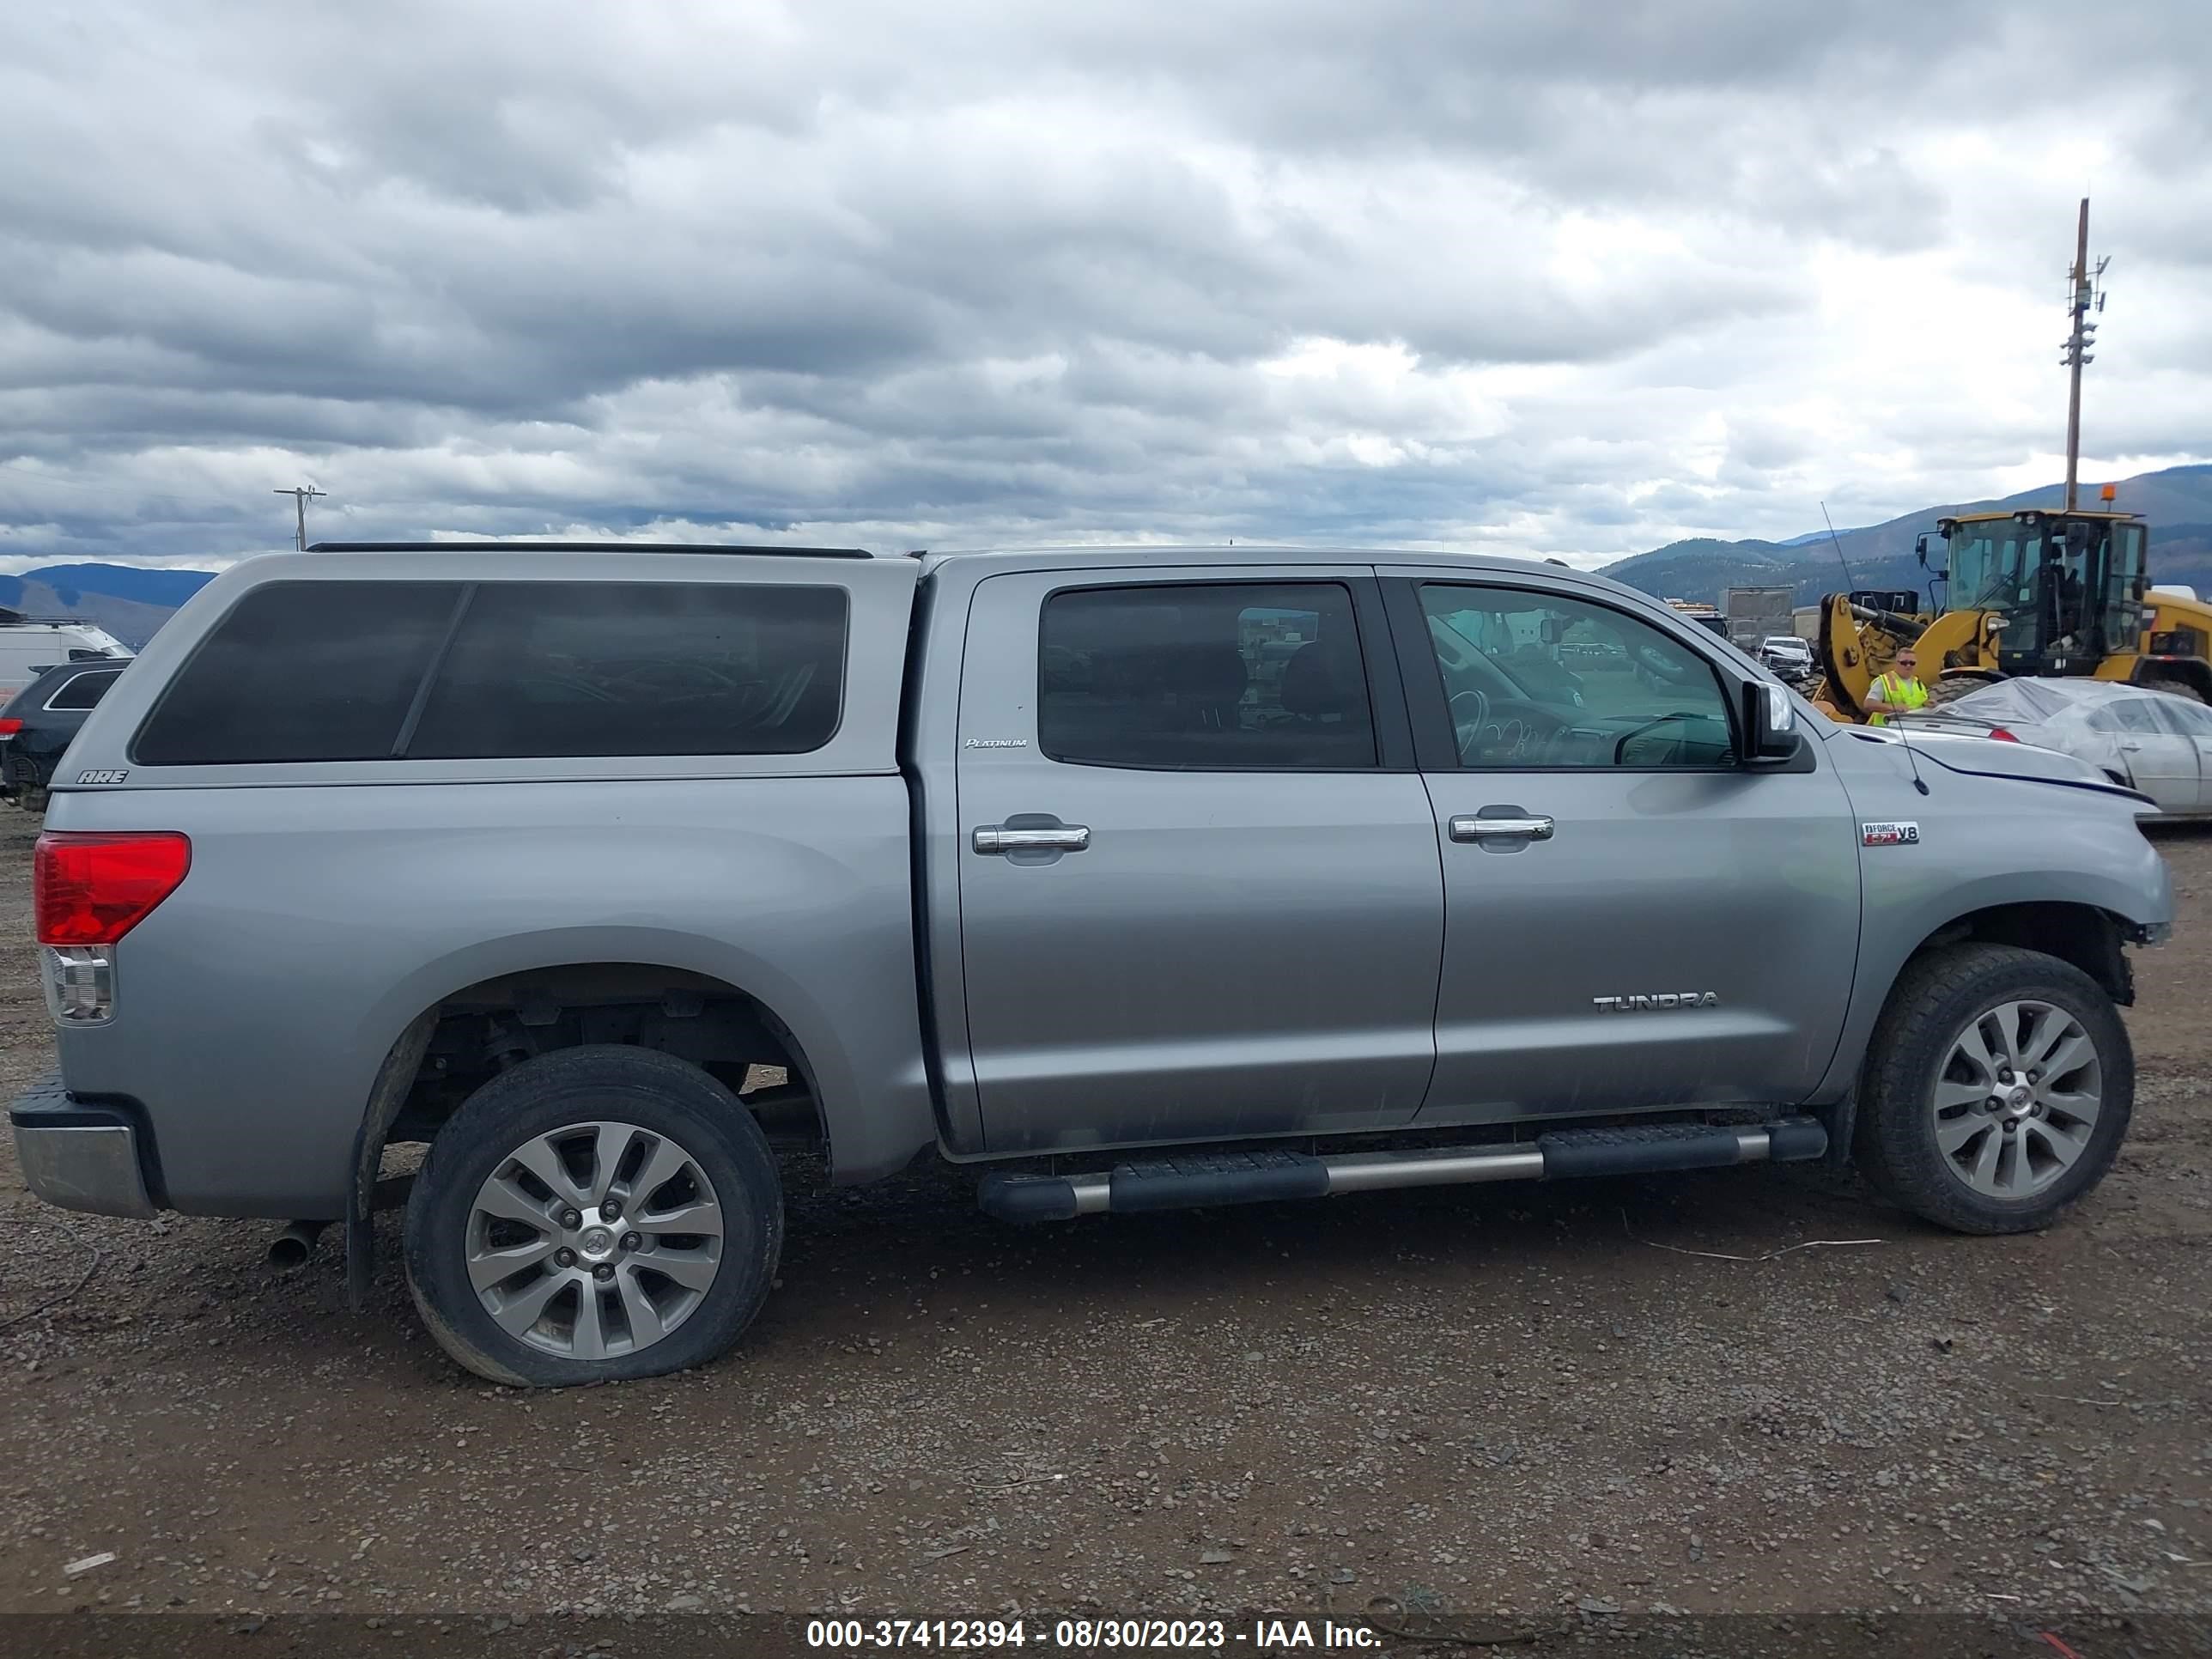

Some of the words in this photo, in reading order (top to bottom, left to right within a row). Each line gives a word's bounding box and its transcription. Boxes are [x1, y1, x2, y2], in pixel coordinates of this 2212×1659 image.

[76, 769, 130, 784] ARE
[1898, 826, 1917, 840] V8
[1593, 991, 1718, 1012] TUNDRA
